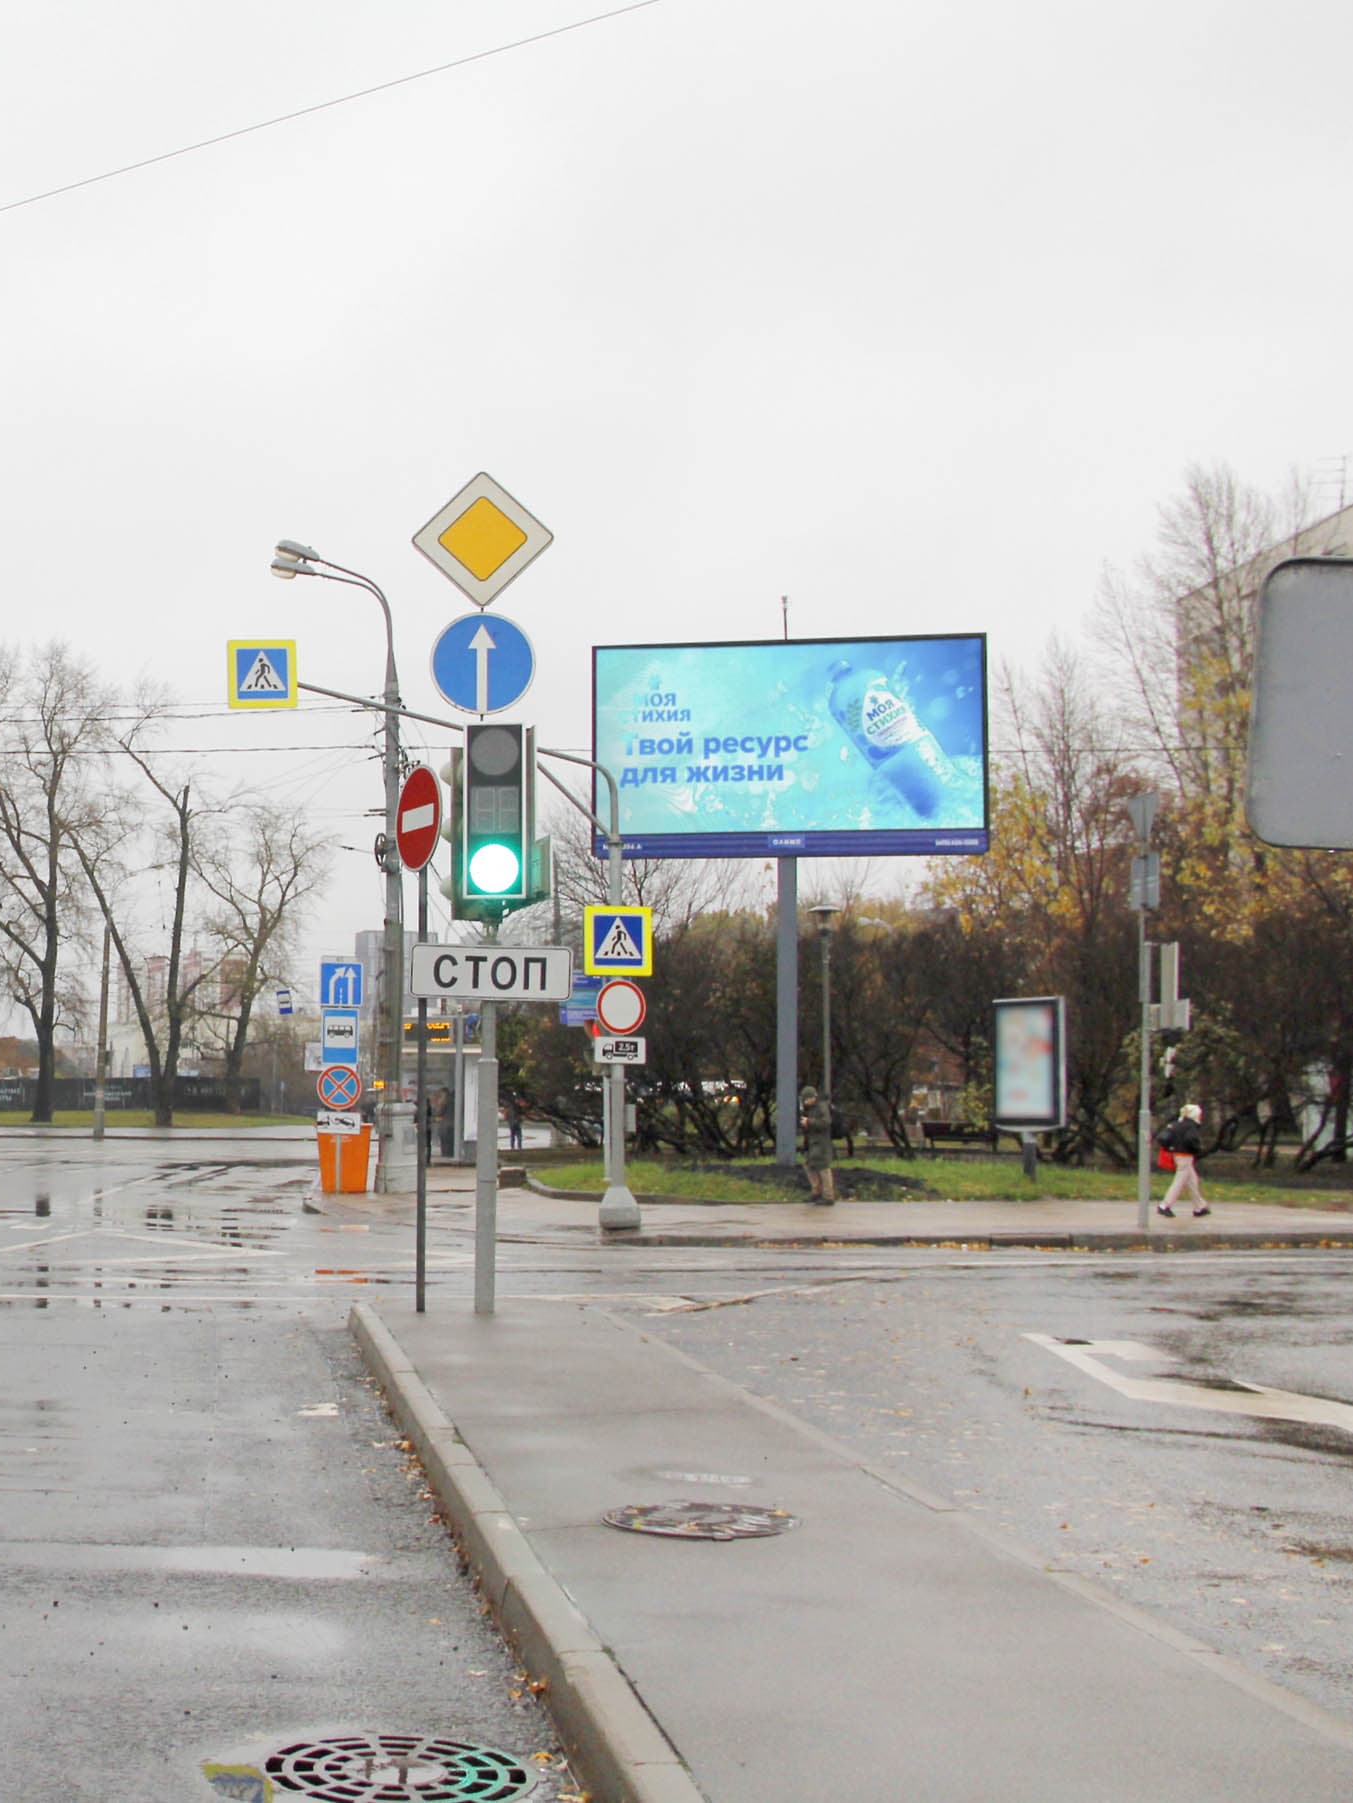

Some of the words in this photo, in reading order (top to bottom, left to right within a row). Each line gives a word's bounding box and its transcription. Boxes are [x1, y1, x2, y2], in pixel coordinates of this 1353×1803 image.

[621, 731, 693, 756] Твой
[703, 734, 808, 759] ресурс
[619, 766, 677, 788] для
[686, 763, 784, 782] жизни
[433, 953, 548, 991] СТОП
